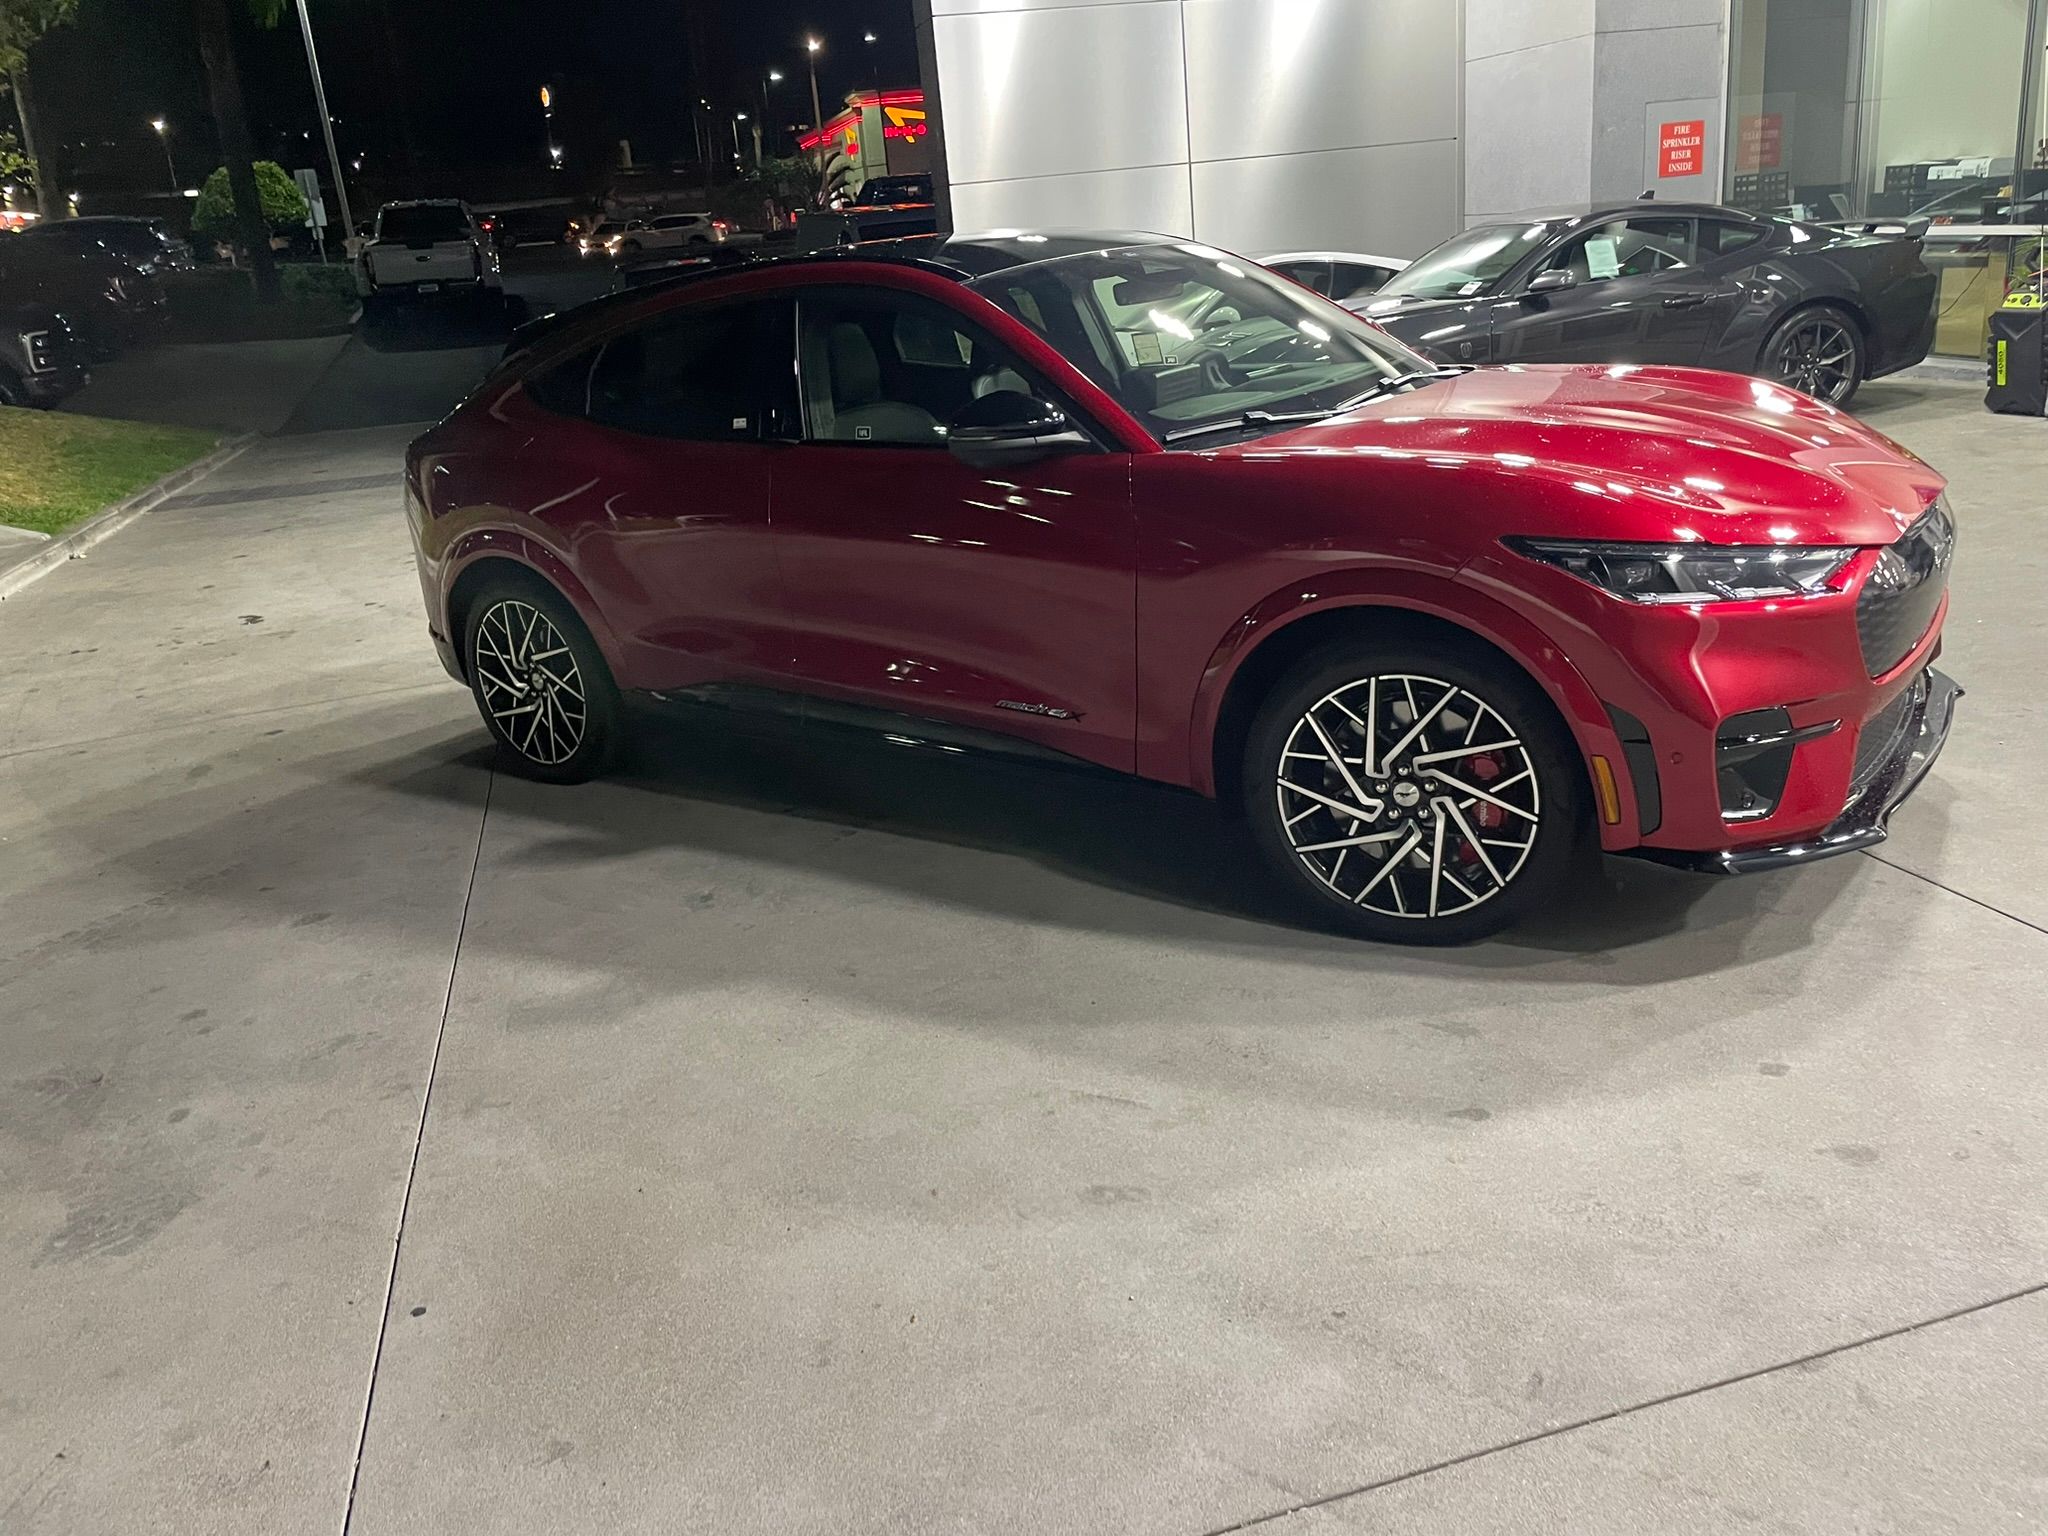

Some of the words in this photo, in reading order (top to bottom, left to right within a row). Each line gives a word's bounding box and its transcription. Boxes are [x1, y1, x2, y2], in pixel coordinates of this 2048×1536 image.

[884, 123, 927, 138] IN-N-O
[1673, 124, 1691, 136] FIRE
[1662, 136, 1701, 149] SPRINKLER
[1670, 149, 1692, 160] RISER
[1668, 161, 1693, 173] INSIDE
